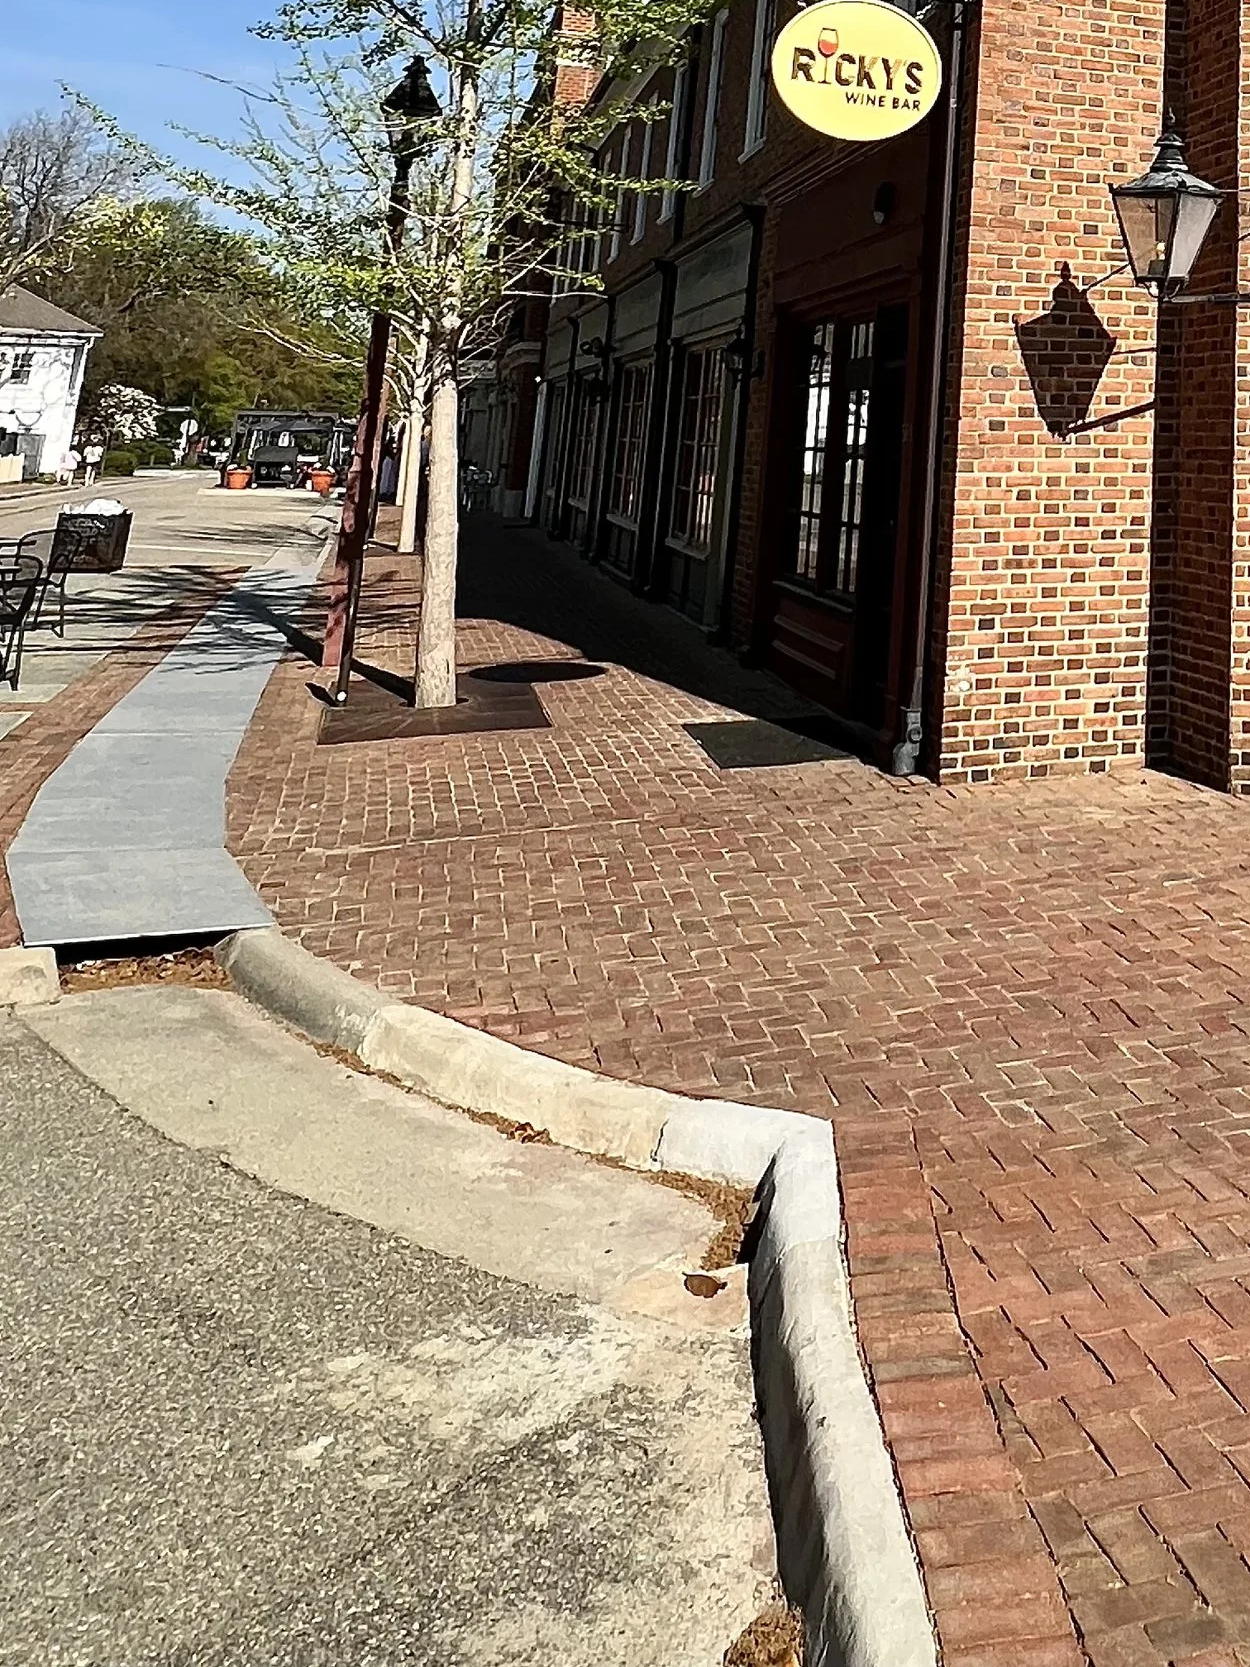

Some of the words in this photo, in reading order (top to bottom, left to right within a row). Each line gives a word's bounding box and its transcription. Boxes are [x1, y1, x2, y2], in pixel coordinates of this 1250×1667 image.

[791, 28, 923, 95] RICKY'S
[846, 92, 886, 107] WINE
[892, 97, 920, 111] BAR
